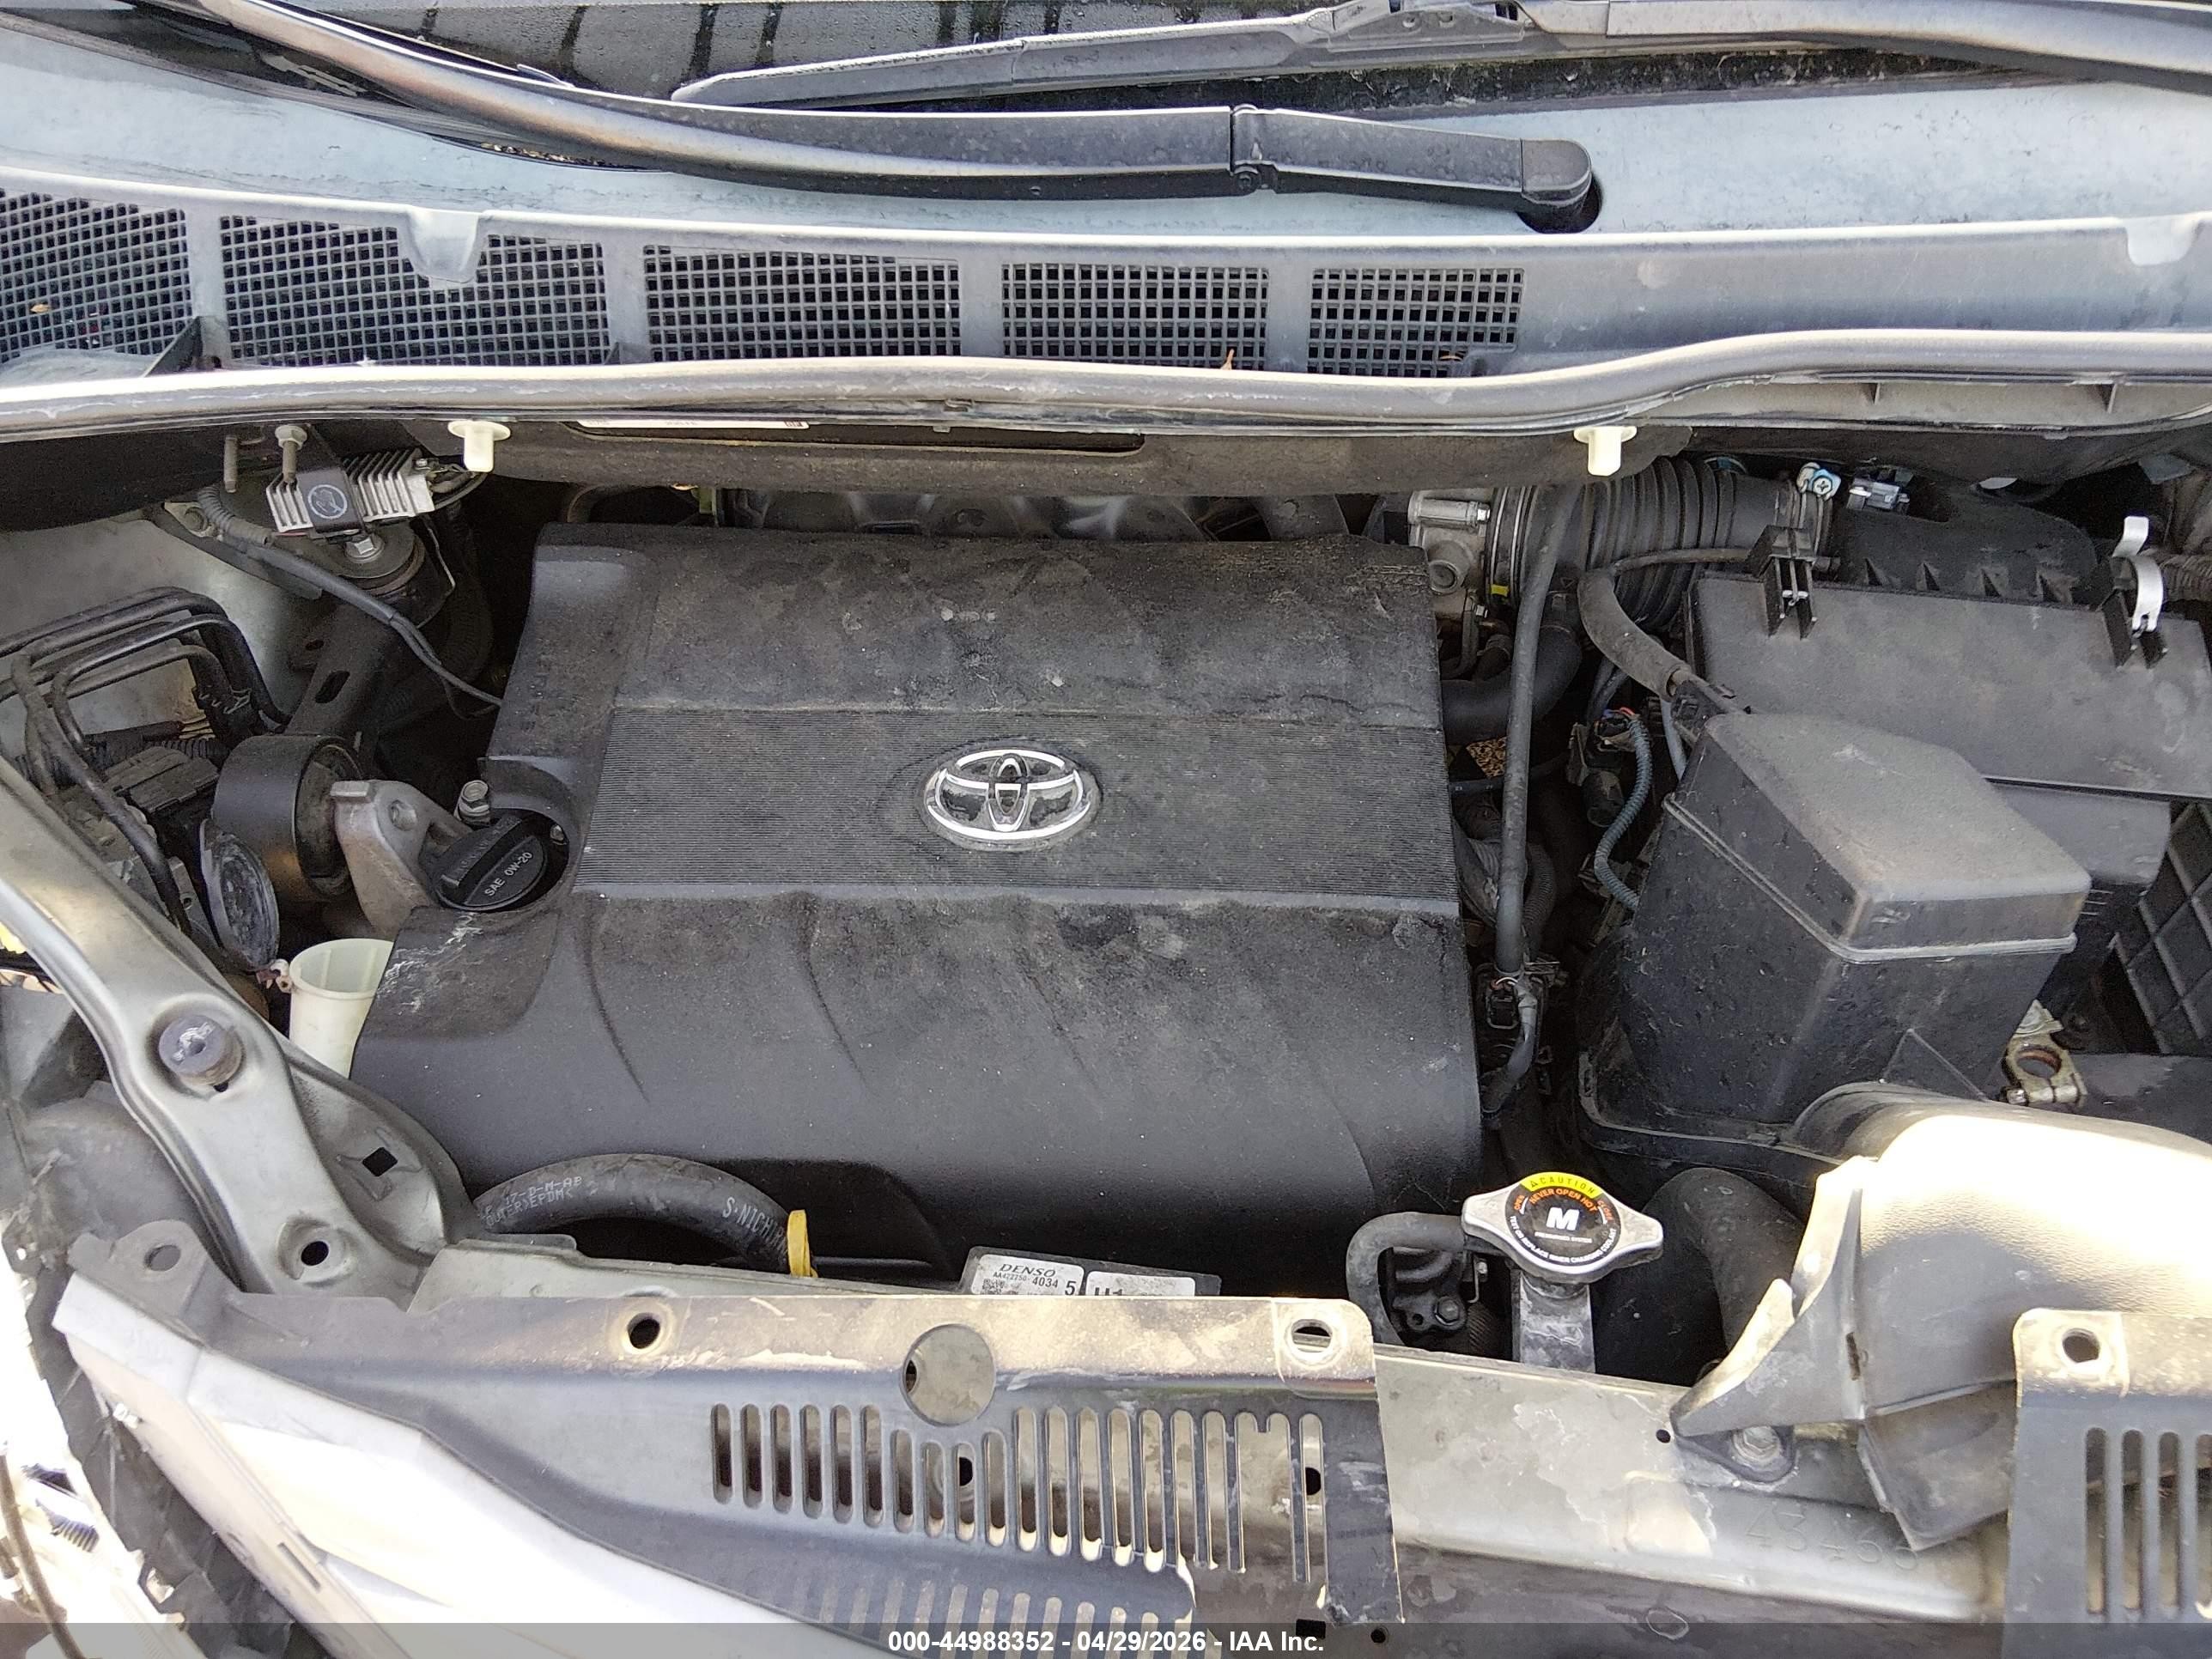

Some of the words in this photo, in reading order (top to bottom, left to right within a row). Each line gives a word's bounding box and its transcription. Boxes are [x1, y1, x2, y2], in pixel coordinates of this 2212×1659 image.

[484, 878, 506, 896] SAE
[504, 852, 532, 877] 0W-20
[1540, 1176, 1595, 1194] CAUTION
[1528, 1188, 1555, 1205] NEVER
[1555, 1188, 1581, 1200] OPEN
[1546, 1206, 1580, 1231] M
[999, 1263, 1056, 1278] DENSO
